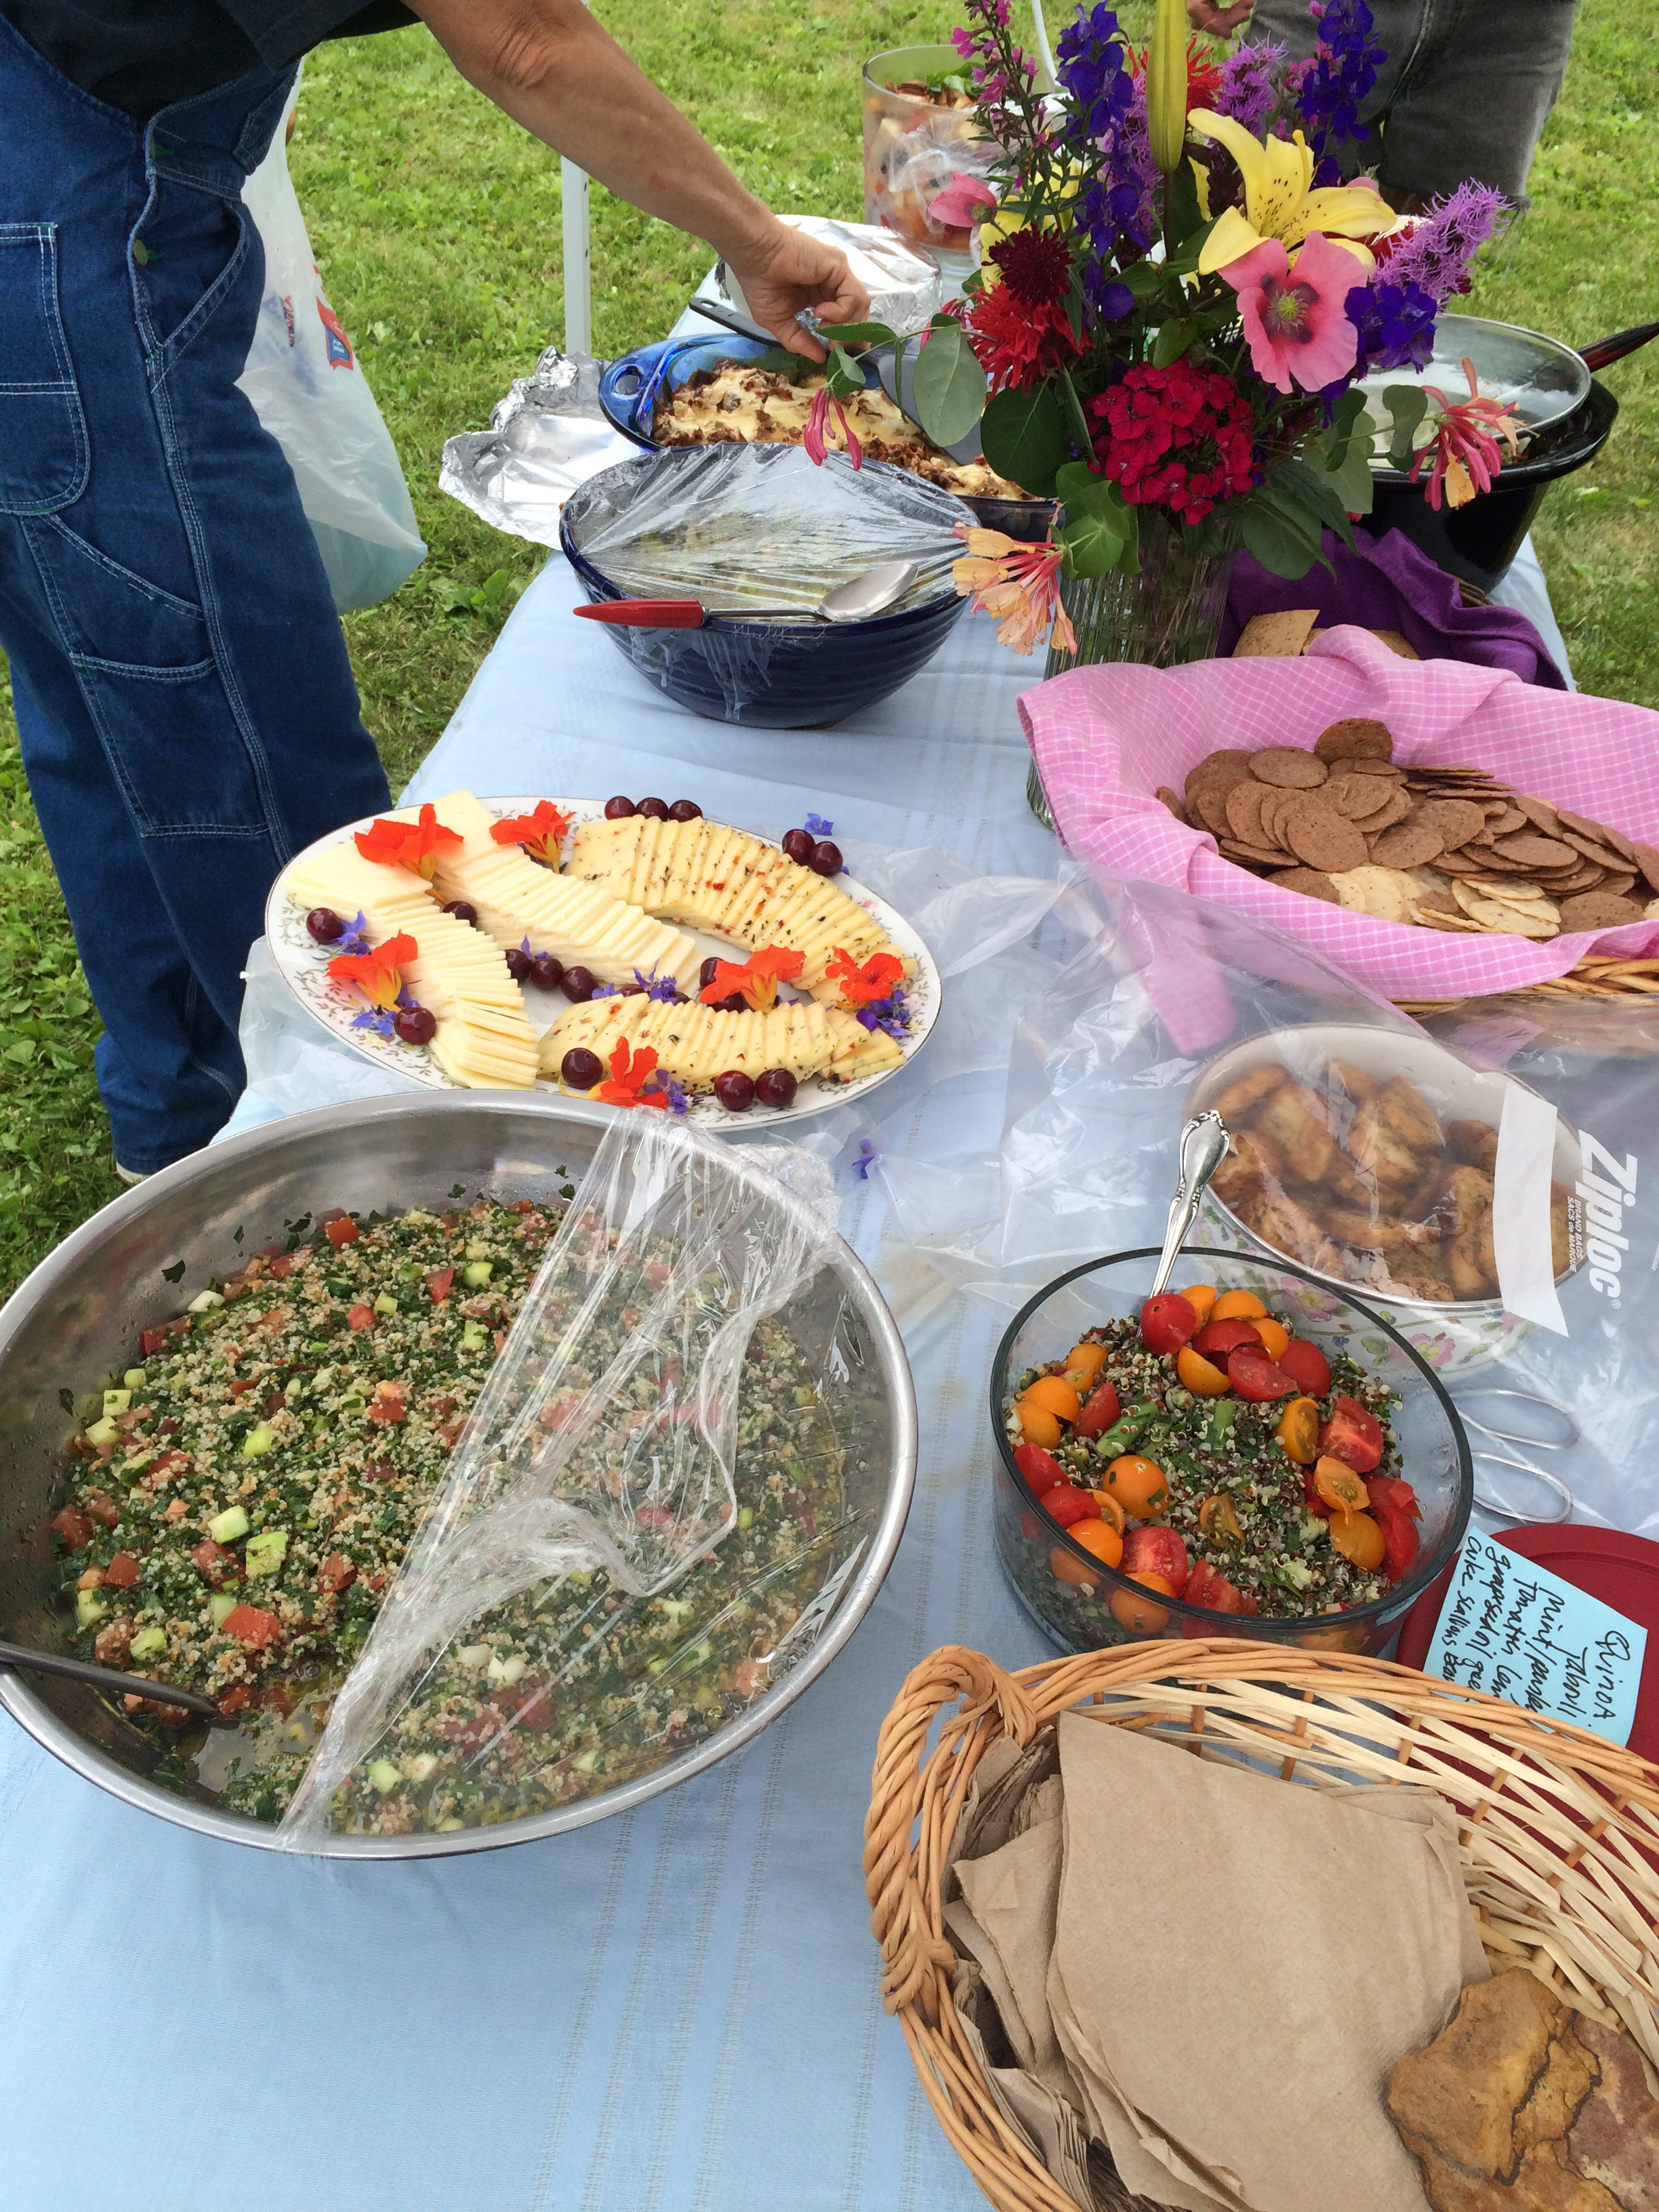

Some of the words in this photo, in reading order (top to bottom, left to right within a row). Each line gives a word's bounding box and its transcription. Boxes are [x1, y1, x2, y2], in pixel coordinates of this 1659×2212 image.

[1568, 1222, 1575, 1232] de
[1574, 1199, 1582, 1232] BRAND
[1569, 1233, 1577, 1273] MARQUE
[1576, 1232, 1584, 1260] BAGS
[1461, 1658, 1484, 1689] gree
